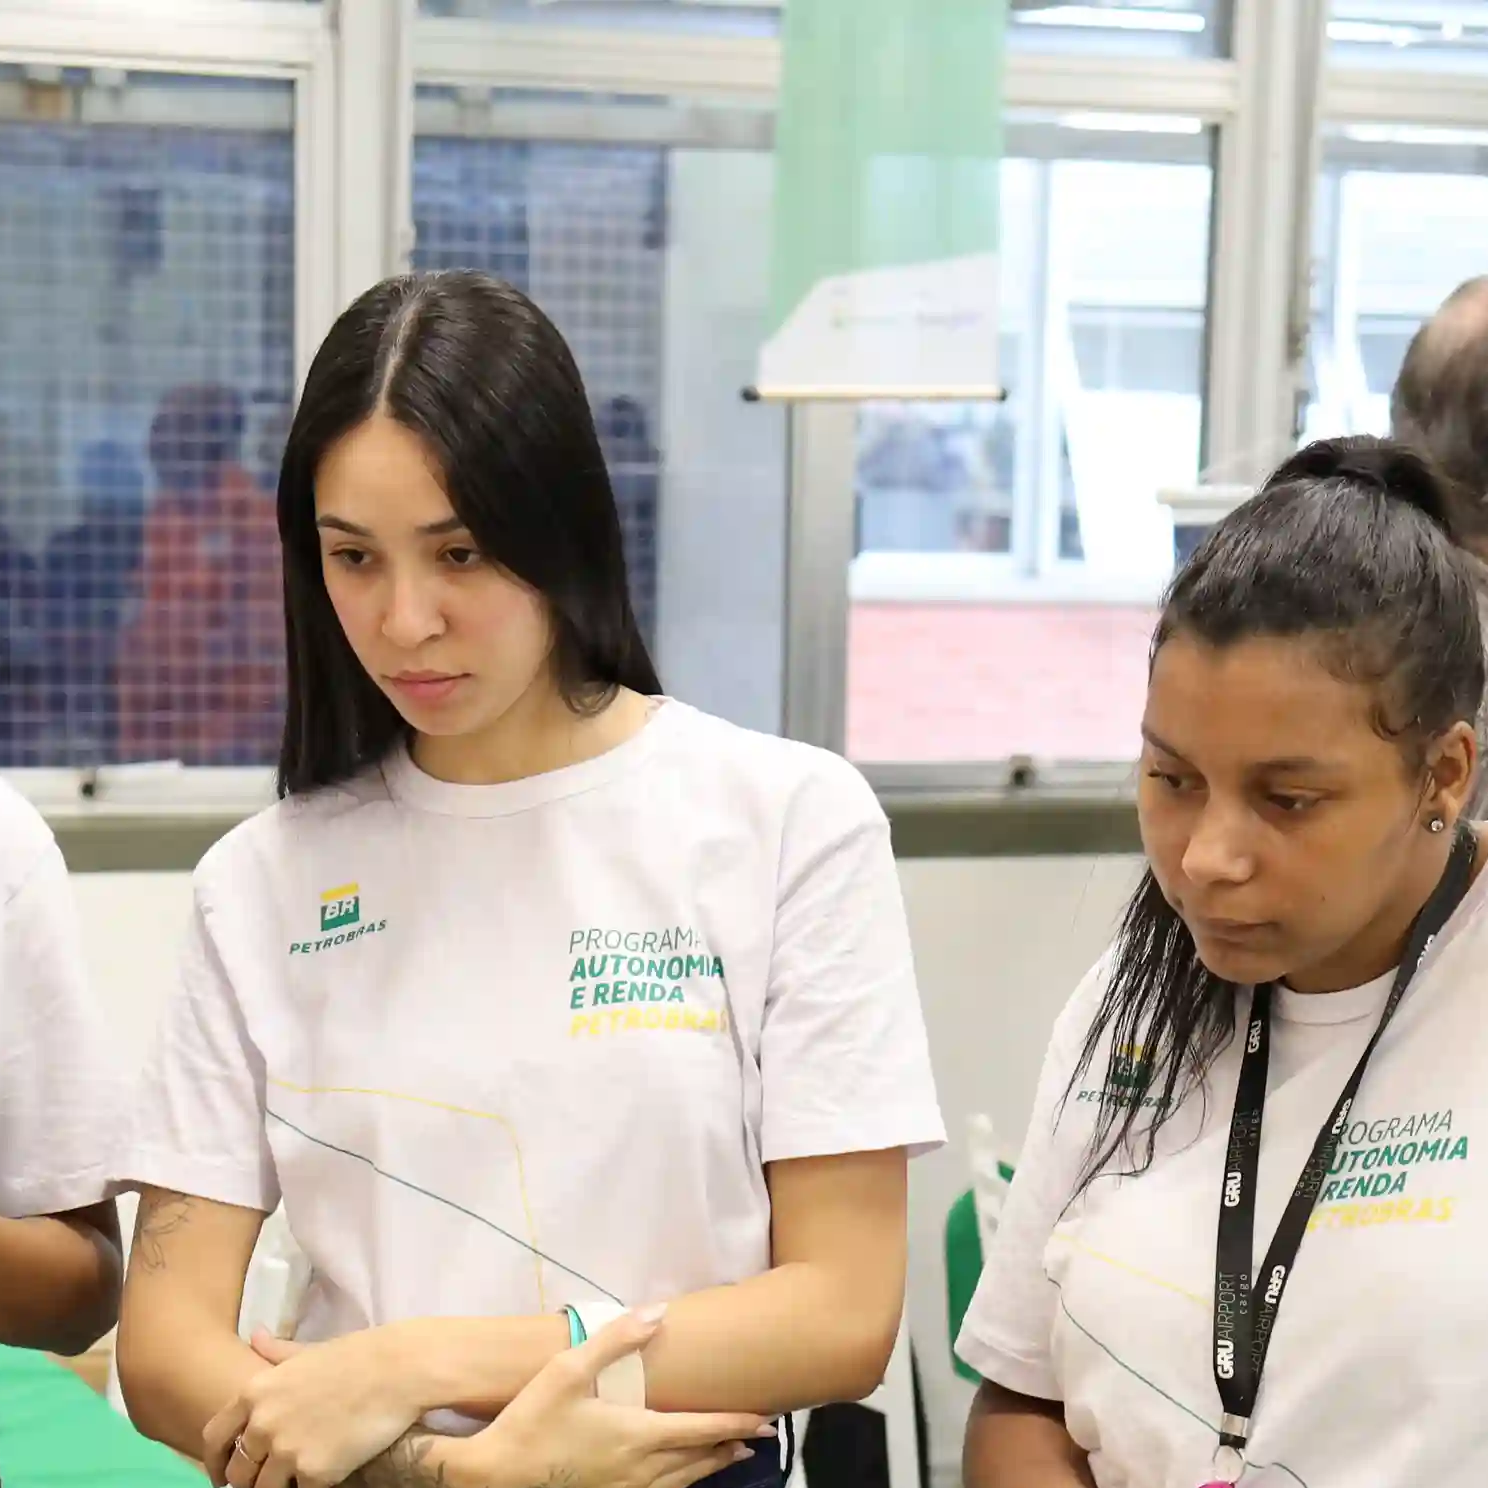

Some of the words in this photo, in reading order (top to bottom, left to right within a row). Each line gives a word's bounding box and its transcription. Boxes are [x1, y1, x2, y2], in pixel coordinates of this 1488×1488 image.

[323, 896, 359, 922] BR
[288, 919, 388, 955] PETROBRAS
[569, 954, 725, 982] AUTONOMIA
[570, 985, 587, 1009] E
[592, 980, 685, 1006] RENDA
[1247, 1020, 1262, 1053] GRU
[1336, 1109, 1454, 1146] ROGRAMA
[1325, 1136, 1469, 1175] UTONOMIA
[1320, 1171, 1408, 1202] RENDA
